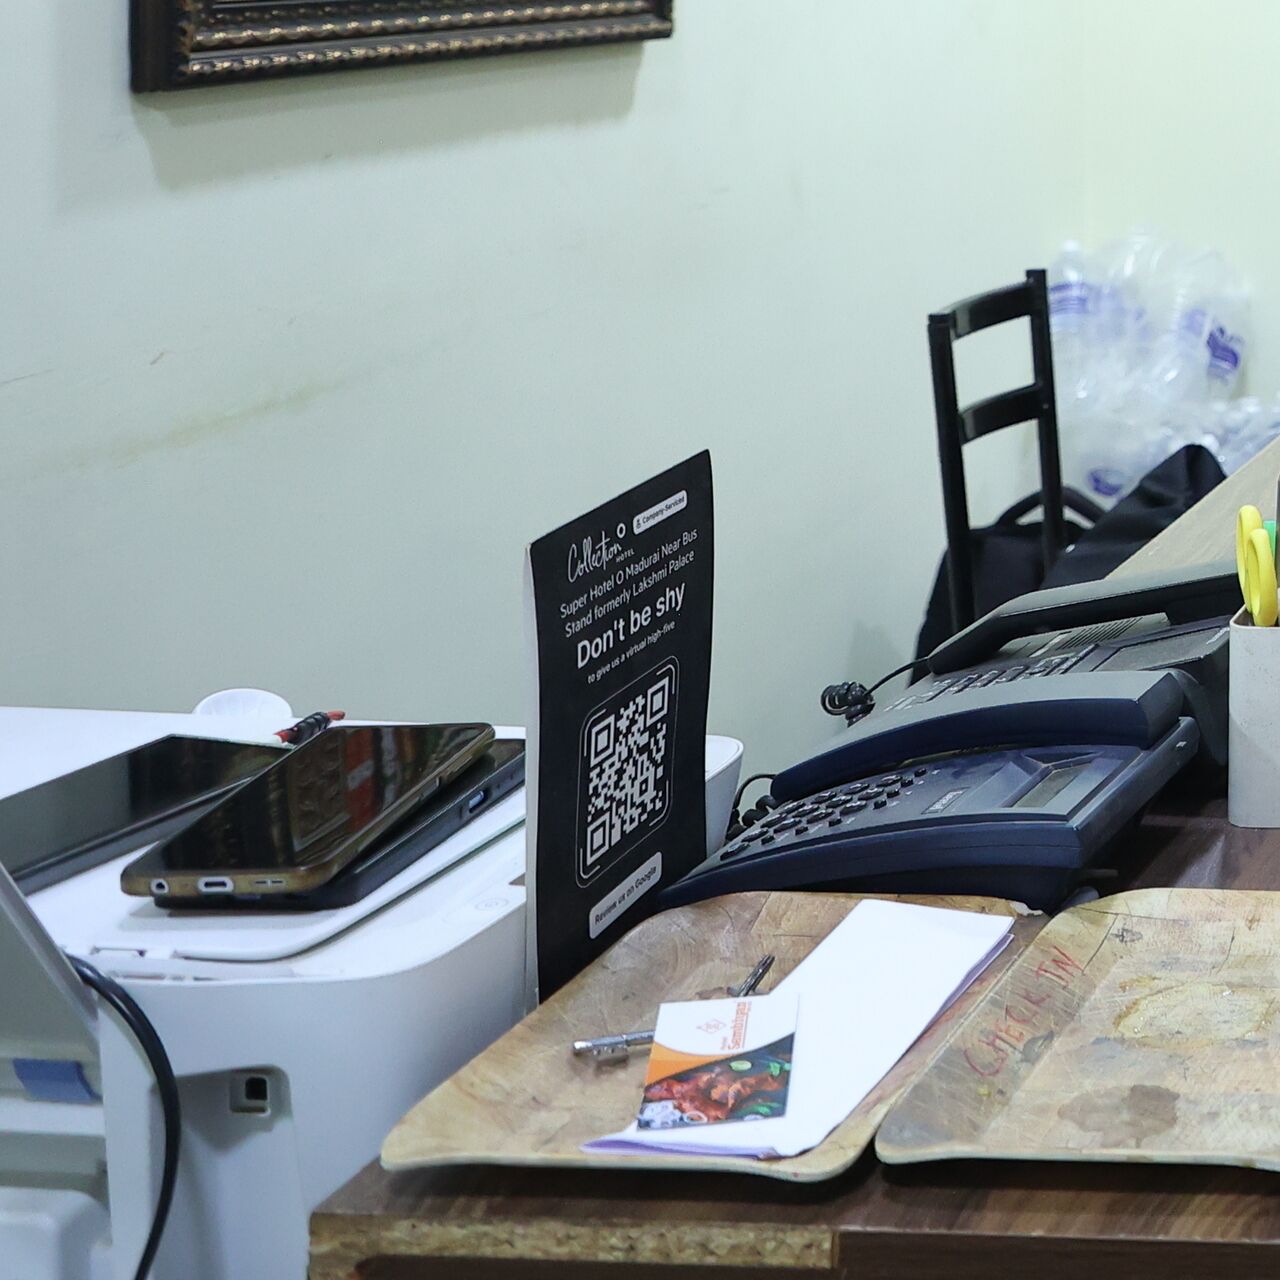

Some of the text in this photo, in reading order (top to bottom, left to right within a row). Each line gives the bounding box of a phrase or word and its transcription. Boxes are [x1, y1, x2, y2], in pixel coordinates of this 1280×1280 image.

[642, 496, 685, 524] Company-Serviced
[560, 529, 698, 618] Super Hotel O Madurai Near Bus
[568, 530, 622, 583] Collection
[615, 548, 635, 563] HOTEL
[565, 550, 695, 638] Stand formerly Lakshmi Palace
[577, 582, 685, 669] Don't be shy
[587, 621, 676, 684] to give us a virtual high-five
[594, 866, 657, 925] Review us on Google
[964, 945, 1085, 1076] CHECK IN
